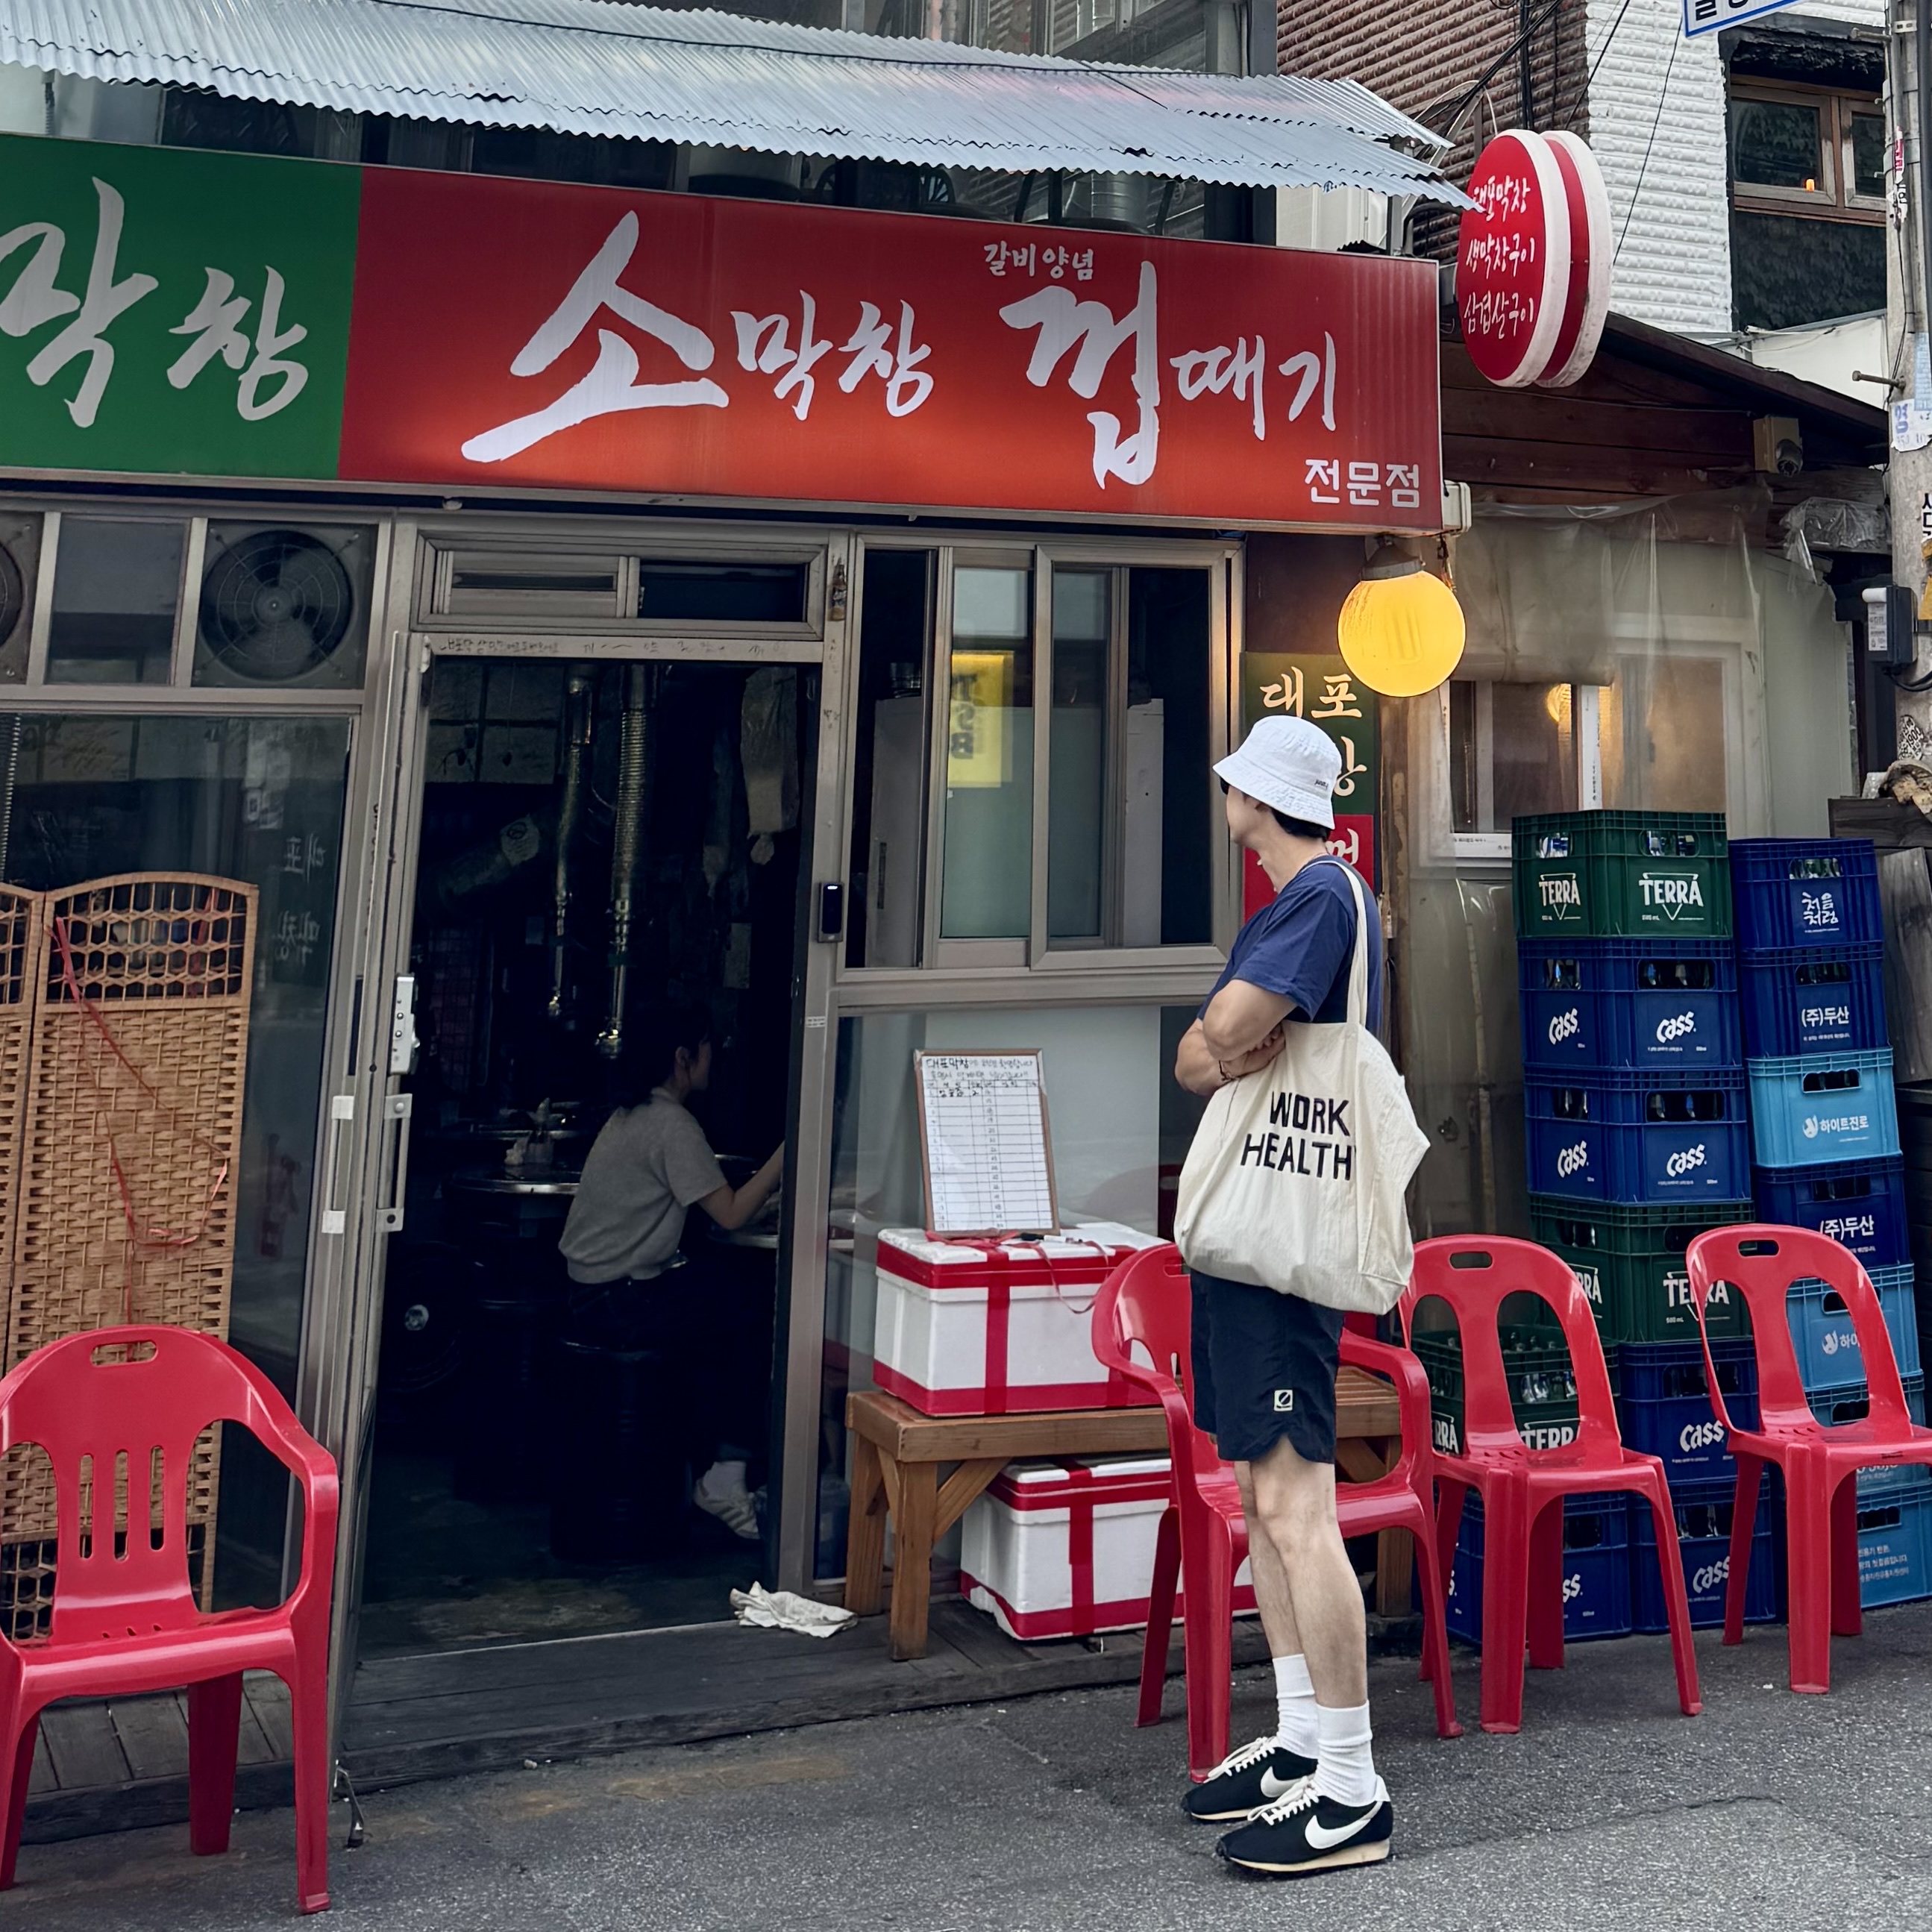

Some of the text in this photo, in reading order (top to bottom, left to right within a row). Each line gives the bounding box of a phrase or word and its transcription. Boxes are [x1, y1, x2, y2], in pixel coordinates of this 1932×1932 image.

[982, 239, 1095, 282] 갈비양념
[1465, 232, 1535, 280] 생막창구이
[1463, 289, 1534, 340] 삼겹살구이
[1304, 458, 1420, 509] 전문점
[1258, 665, 1364, 718] 대포
[1538, 879, 1581, 907] TERRA
[1638, 878, 1704, 908] TERRA
[1801, 891, 1835, 912] 처음
[1802, 909, 1840, 926] 처럼
[1549, 1008, 1579, 1045] Cass
[1656, 1011, 1695, 1044] Cass
[1801, 1005, 1850, 1028] (주)두산
[1269, 1091, 1350, 1137] WORK
[1819, 1114, 1869, 1133] 하이트진로
[1240, 1132, 1357, 1181] HEALTH
[1557, 1140, 1588, 1179] Cass
[1666, 1144, 1706, 1178] Cass
[1819, 1214, 1875, 1241] (주)두산
[1679, 1419, 1725, 1453] Cass
